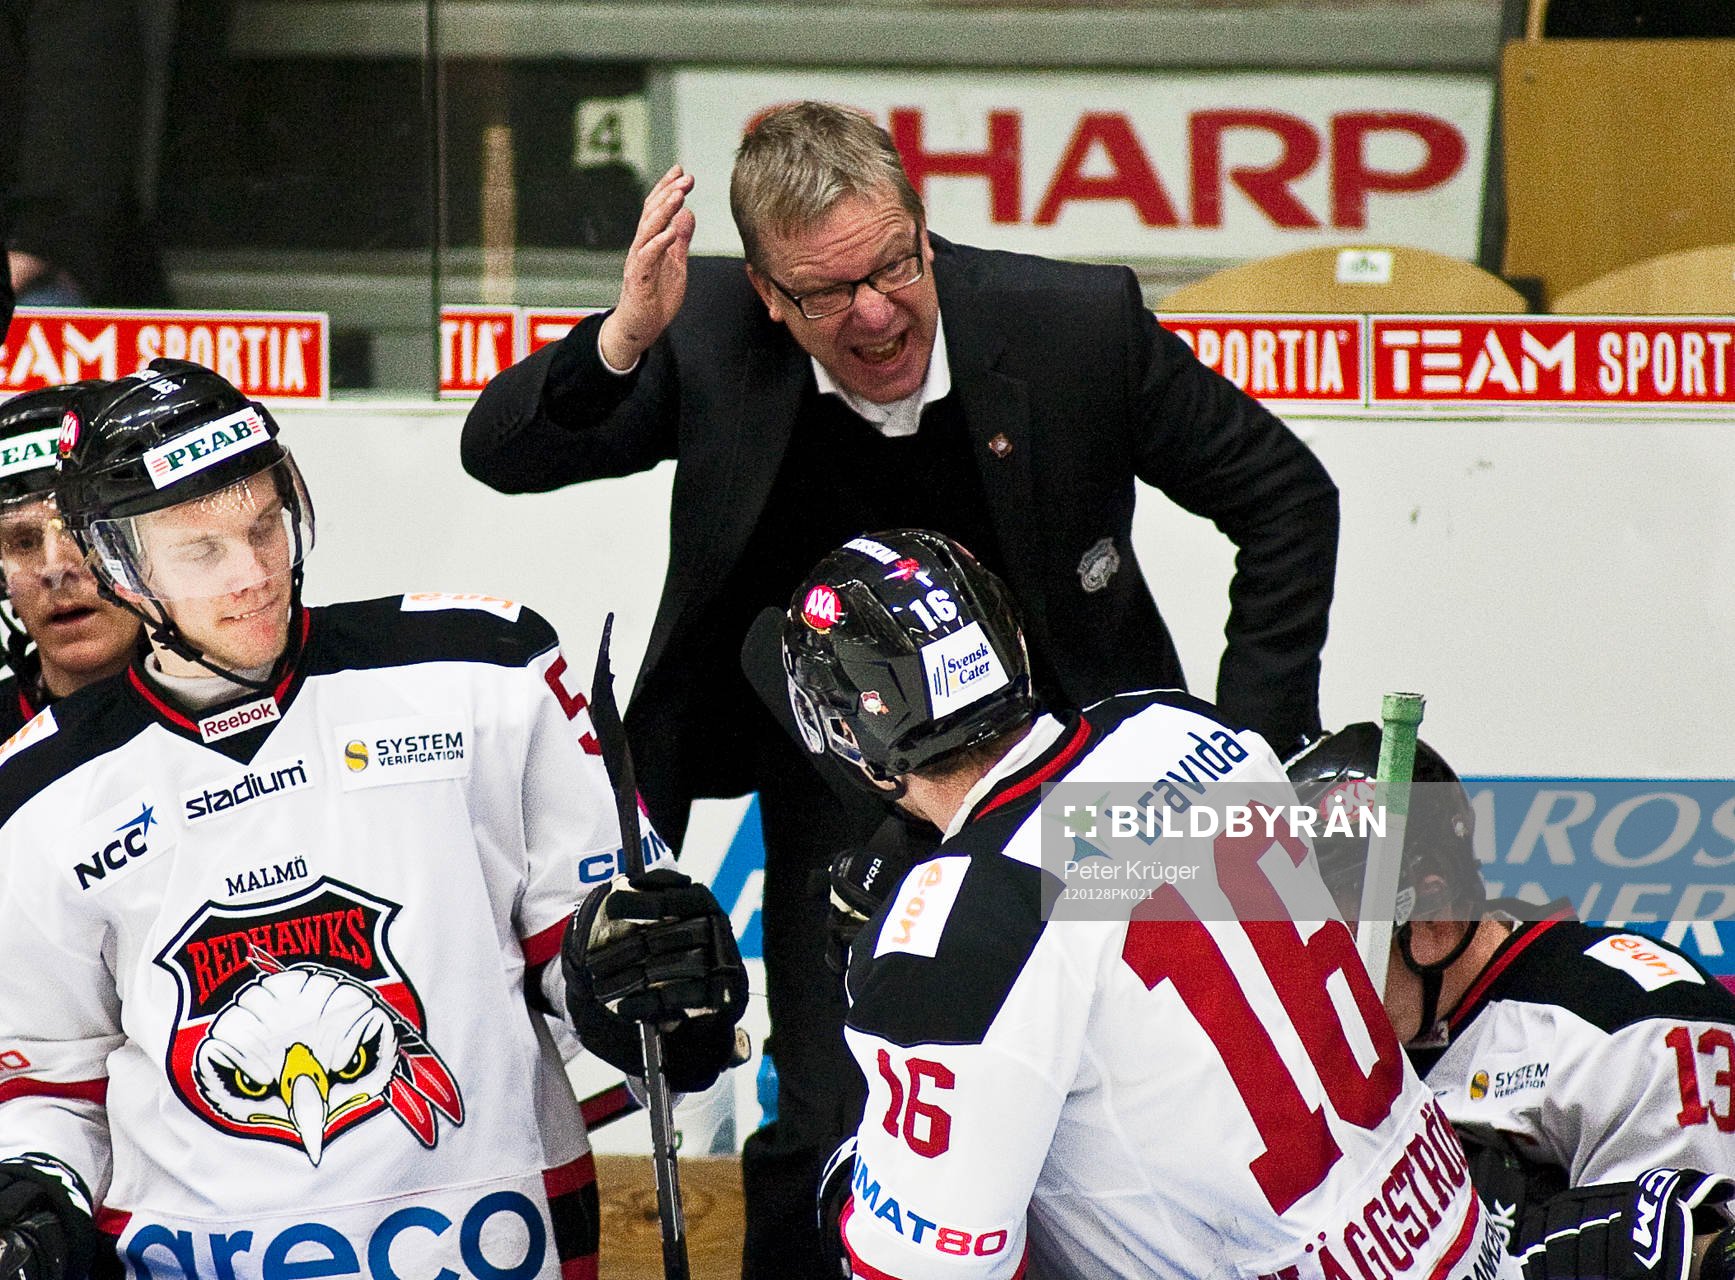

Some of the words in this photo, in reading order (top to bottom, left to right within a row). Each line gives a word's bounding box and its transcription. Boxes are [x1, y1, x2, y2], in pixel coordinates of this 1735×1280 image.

[745, 106, 1466, 231] HARP
[1175, 328, 1344, 393] PORTIA
[1382, 328, 1577, 395] TEAM
[163, 419, 253, 472] PEAB
[805, 588, 837, 621] AXA
[909, 589, 957, 632] 16
[947, 642, 989, 674] Svensk
[959, 661, 990, 684] Cater
[203, 702, 275, 737] Reebok
[376, 731, 464, 757] SYSTEM
[378, 750, 465, 767] VERIFICATION
[186, 759, 307, 820] stadium
[73, 828, 148, 890] NCC
[225, 856, 308, 896] MALMÖ
[187, 906, 373, 1006] REDHAWKS
[1122, 800, 1405, 1216] 16
[877, 1048, 956, 1159] 16
[1665, 1026, 1735, 1134] 13
[1258, 1097, 1470, 1280] ÄGGSTRÖ
